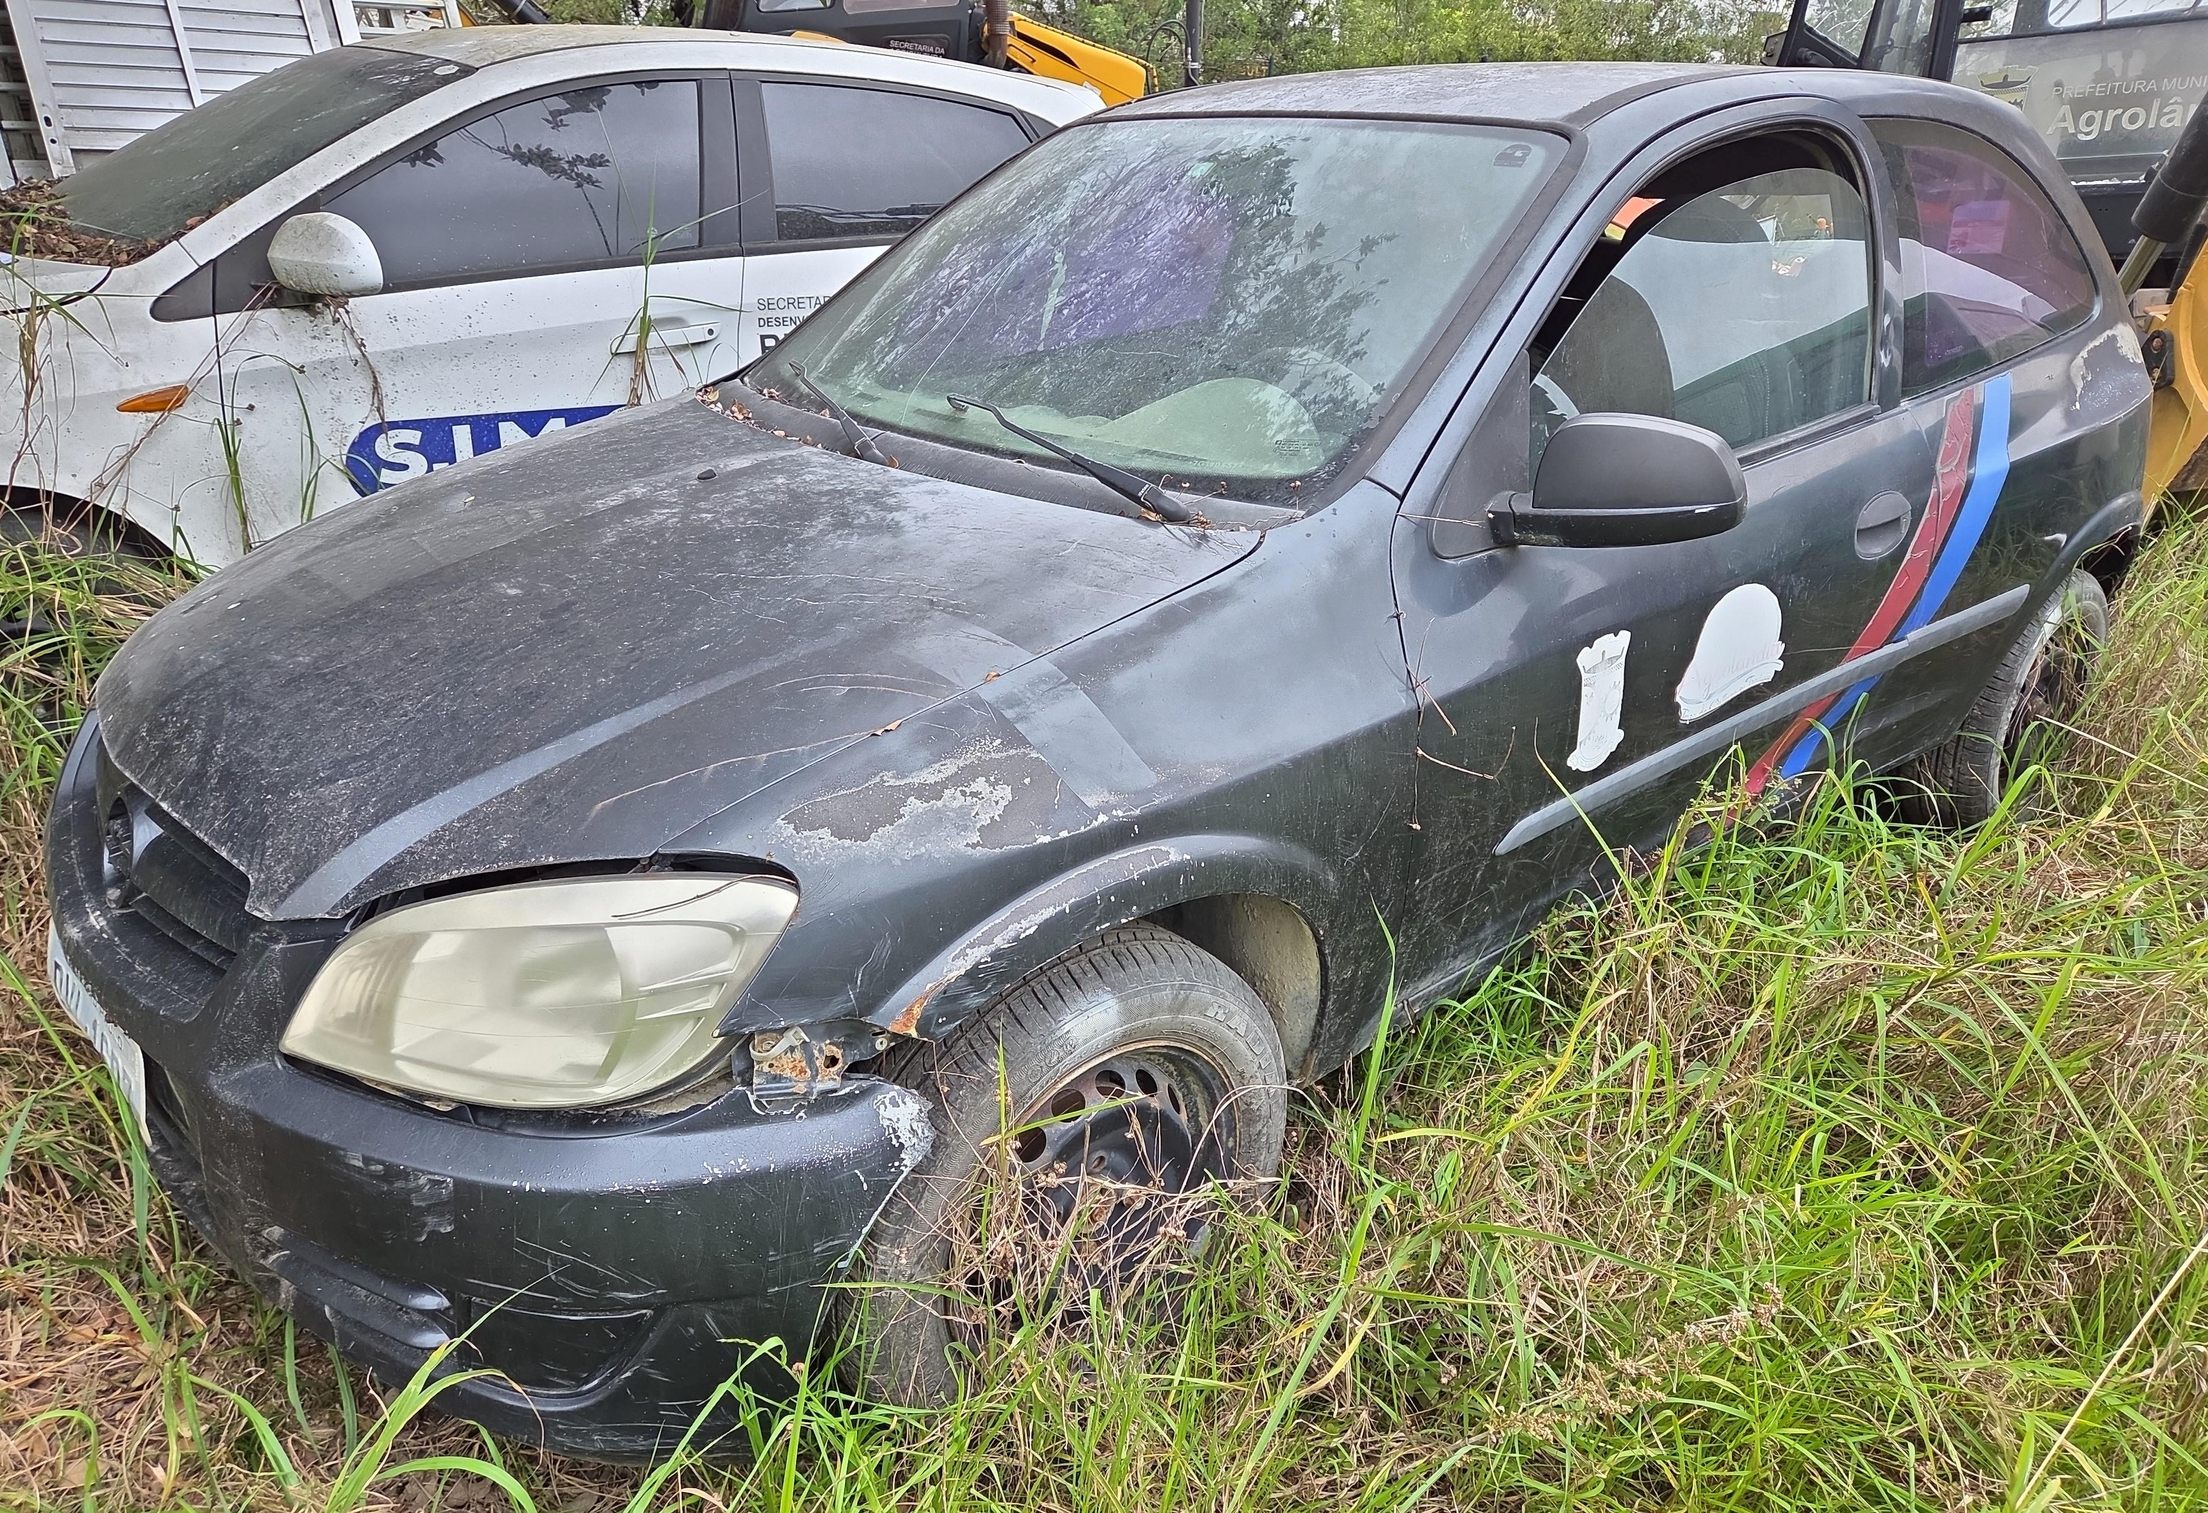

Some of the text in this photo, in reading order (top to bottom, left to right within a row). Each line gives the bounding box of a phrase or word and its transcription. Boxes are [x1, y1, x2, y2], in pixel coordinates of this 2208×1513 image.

[890, 40, 934, 54] SECRETARIA
[935, 46, 945, 55] DA
[2052, 79, 2157, 98] PREFEITURA
